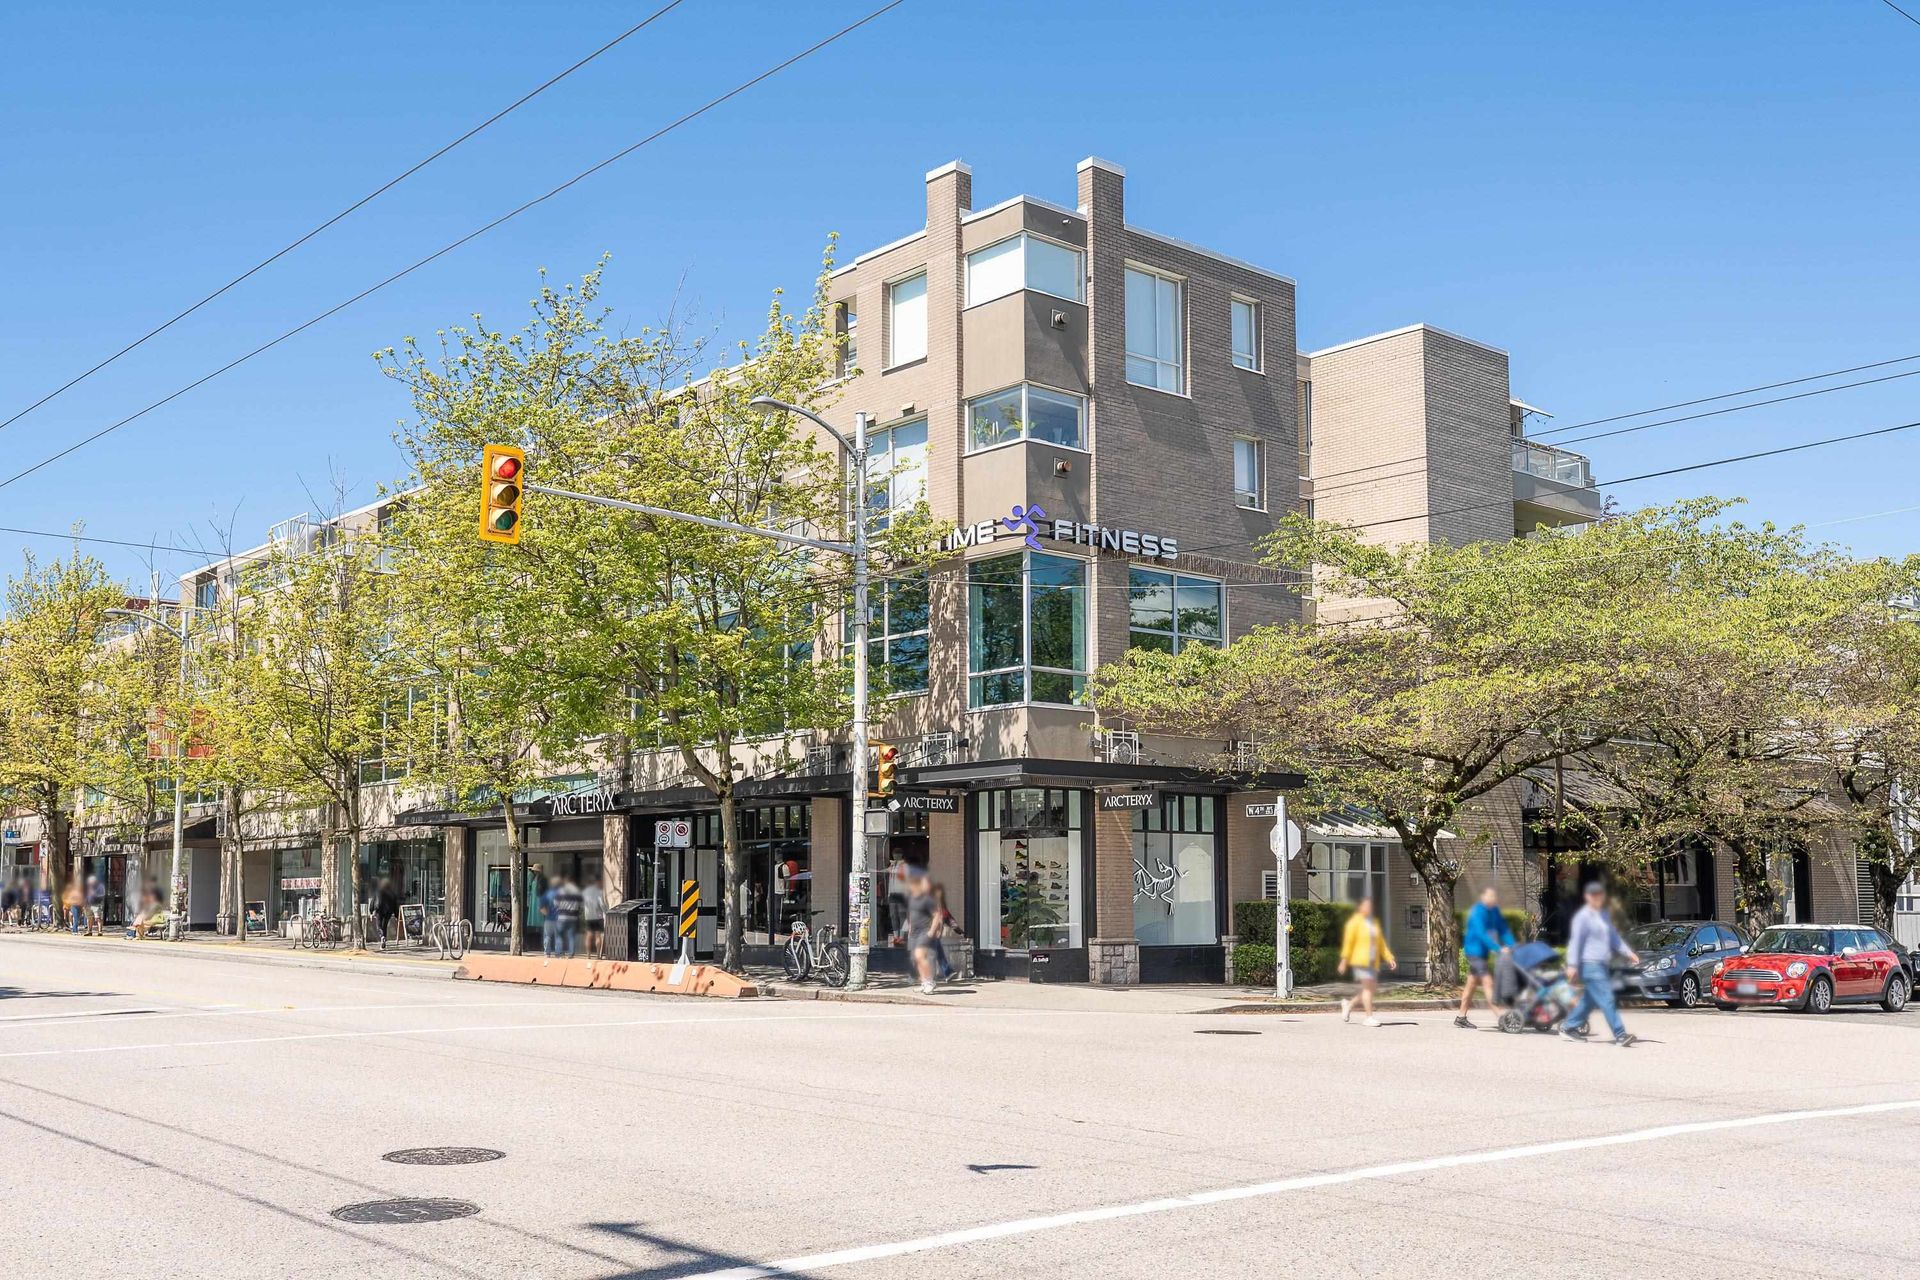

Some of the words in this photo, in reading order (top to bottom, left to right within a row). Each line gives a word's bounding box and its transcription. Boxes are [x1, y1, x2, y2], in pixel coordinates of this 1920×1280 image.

[1055, 519, 1178, 560] FITNESS
[903, 796, 953, 810] ARC'TERYX
[1104, 793, 1153, 808] ARC'TERYX
